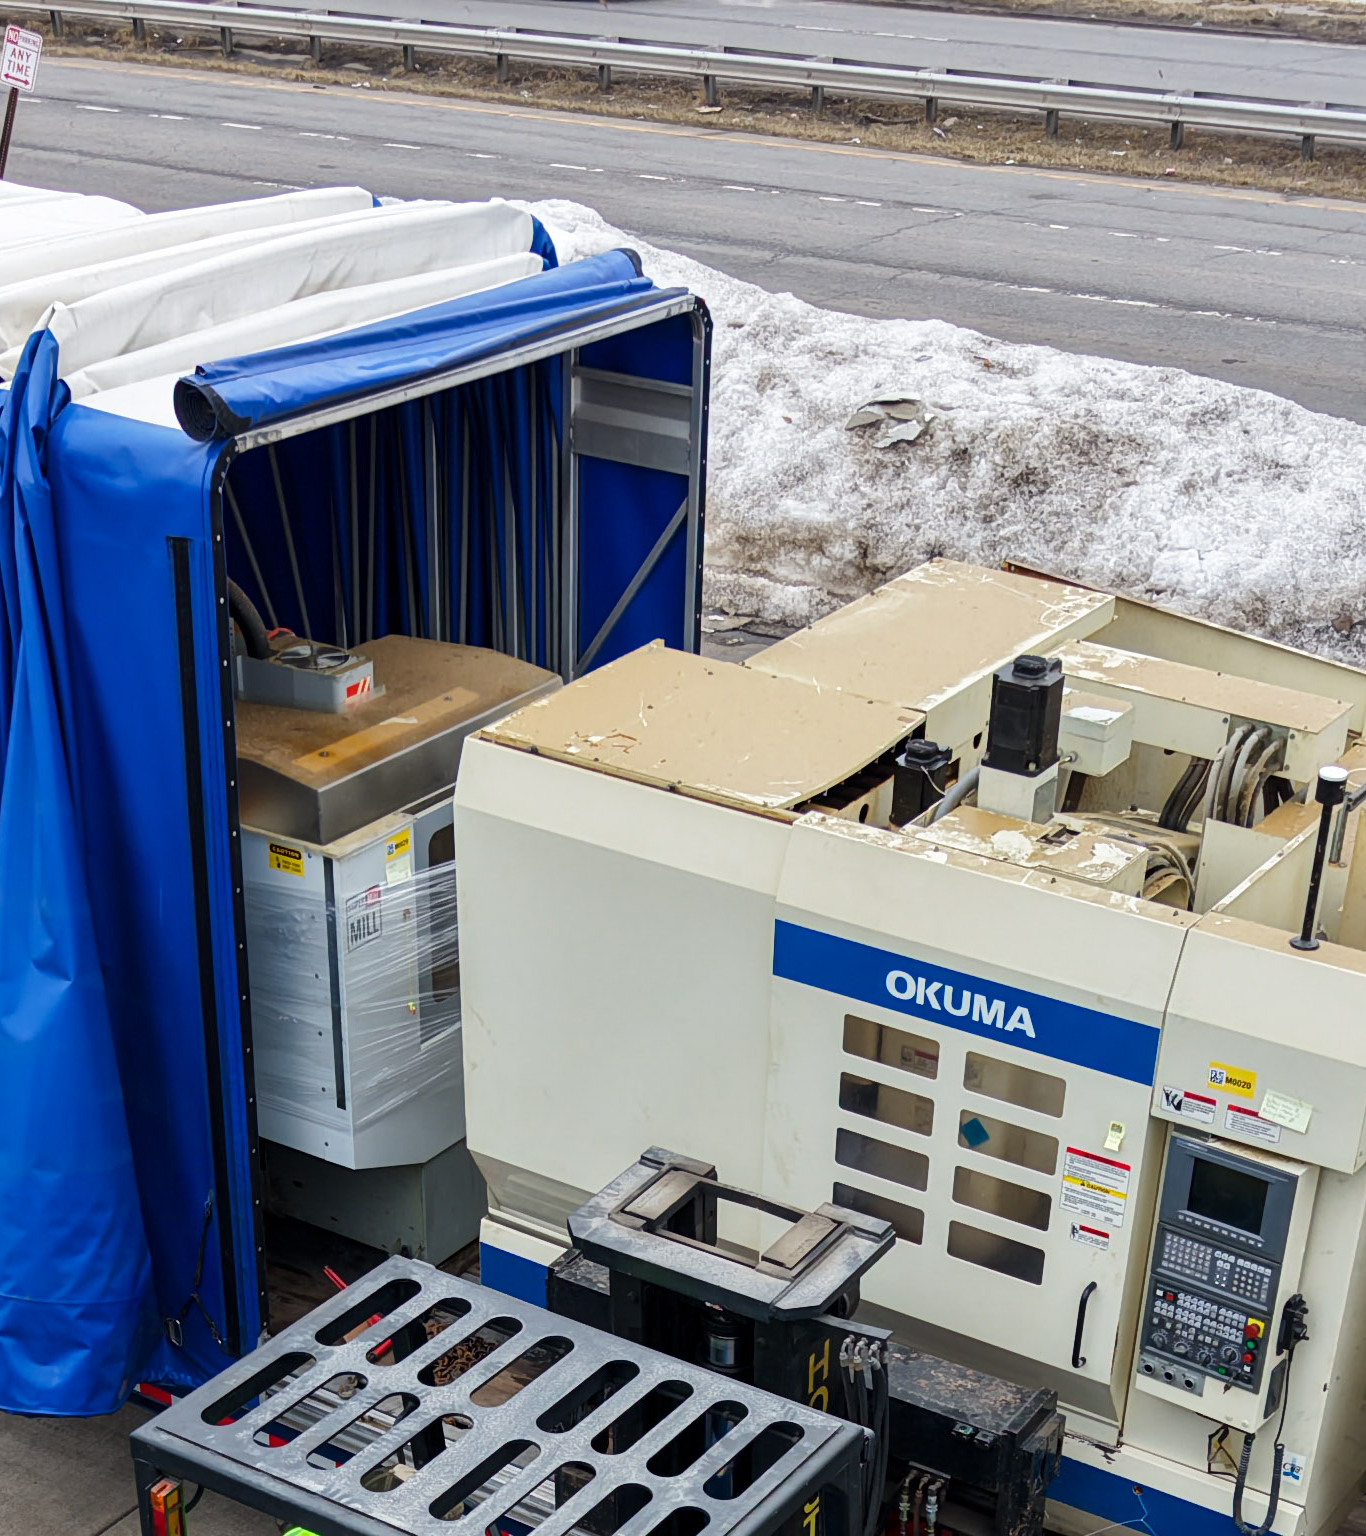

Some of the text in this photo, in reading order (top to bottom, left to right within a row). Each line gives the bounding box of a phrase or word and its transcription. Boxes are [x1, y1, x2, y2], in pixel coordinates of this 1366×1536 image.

[8, 30, 39, 48] NO PARKING
[10, 47, 32, 63] ANY
[8, 59, 31, 77] TIME
[350, 911, 379, 945] MILL
[885, 969, 1036, 1039] OKUMA
[1226, 1076, 1251, 1090] M0020
